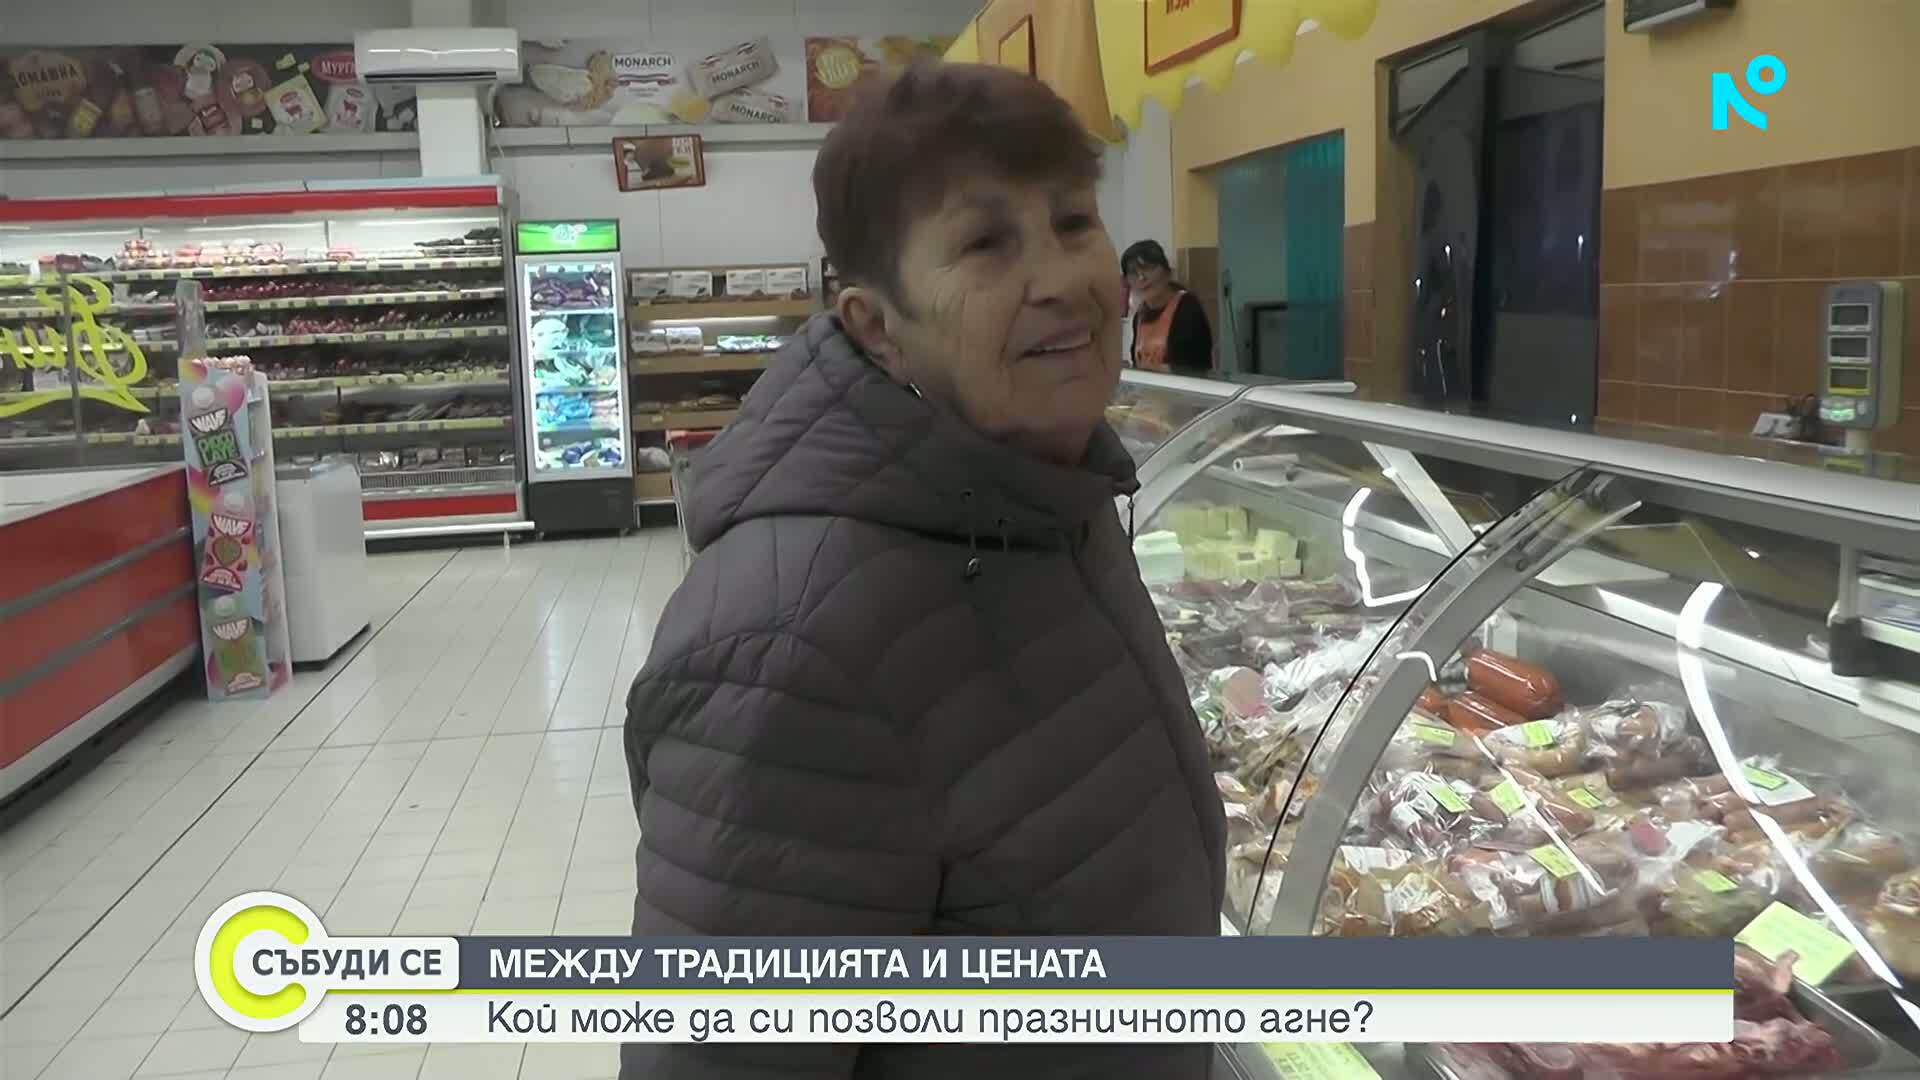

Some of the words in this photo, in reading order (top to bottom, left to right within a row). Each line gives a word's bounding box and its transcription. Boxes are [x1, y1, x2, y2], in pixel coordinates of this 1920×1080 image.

[615, 56, 672, 67] MONARCH
[711, 60, 760, 84] MONARCH
[730, 102, 783, 125] MONARCH
